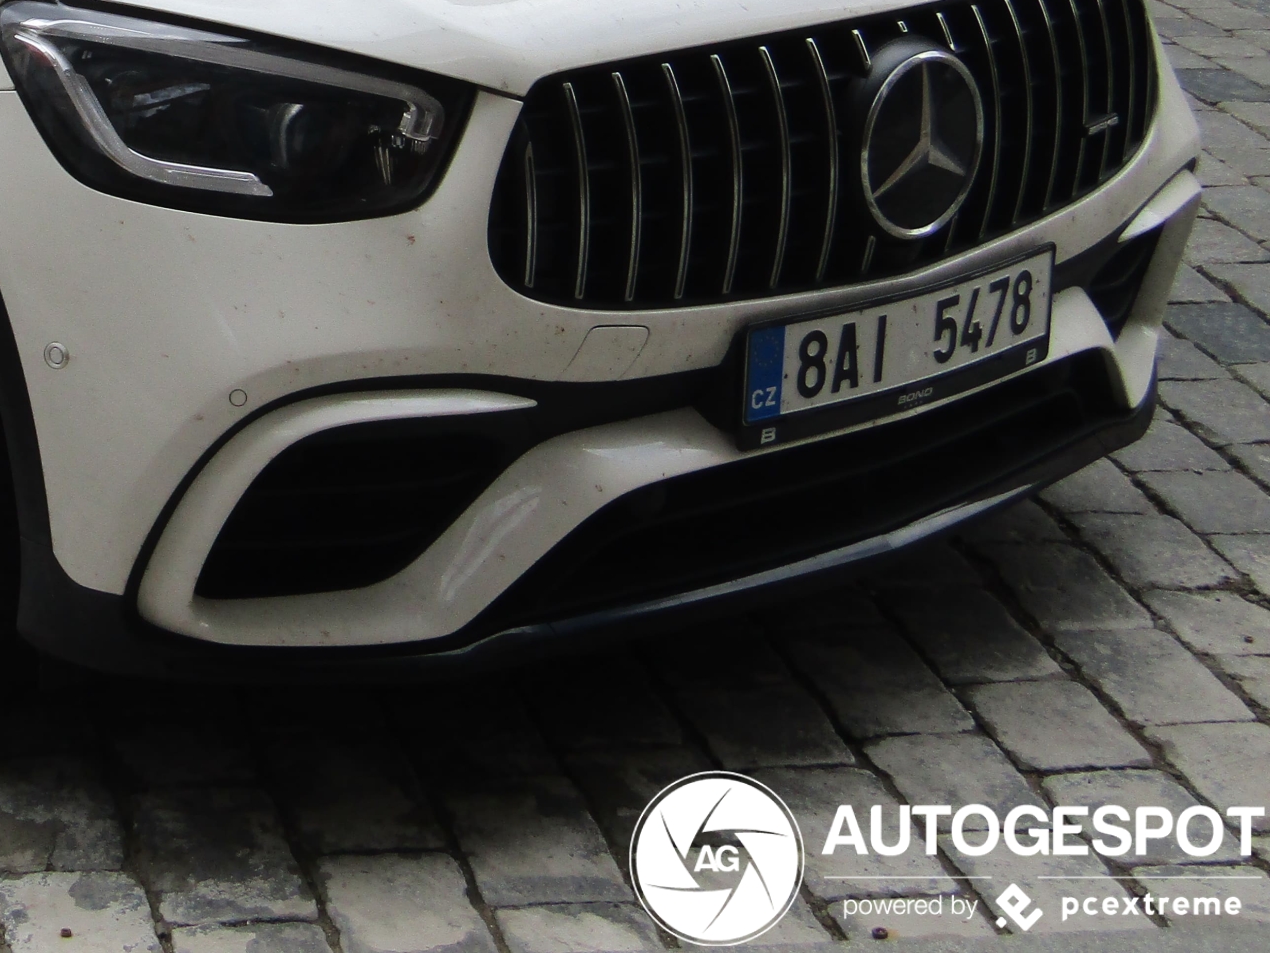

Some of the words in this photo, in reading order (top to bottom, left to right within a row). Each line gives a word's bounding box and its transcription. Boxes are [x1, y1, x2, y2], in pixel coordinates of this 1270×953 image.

[796, 315, 888, 400] 8AI
[933, 269, 1033, 364] 5478
[751, 386, 777, 409] CZ
